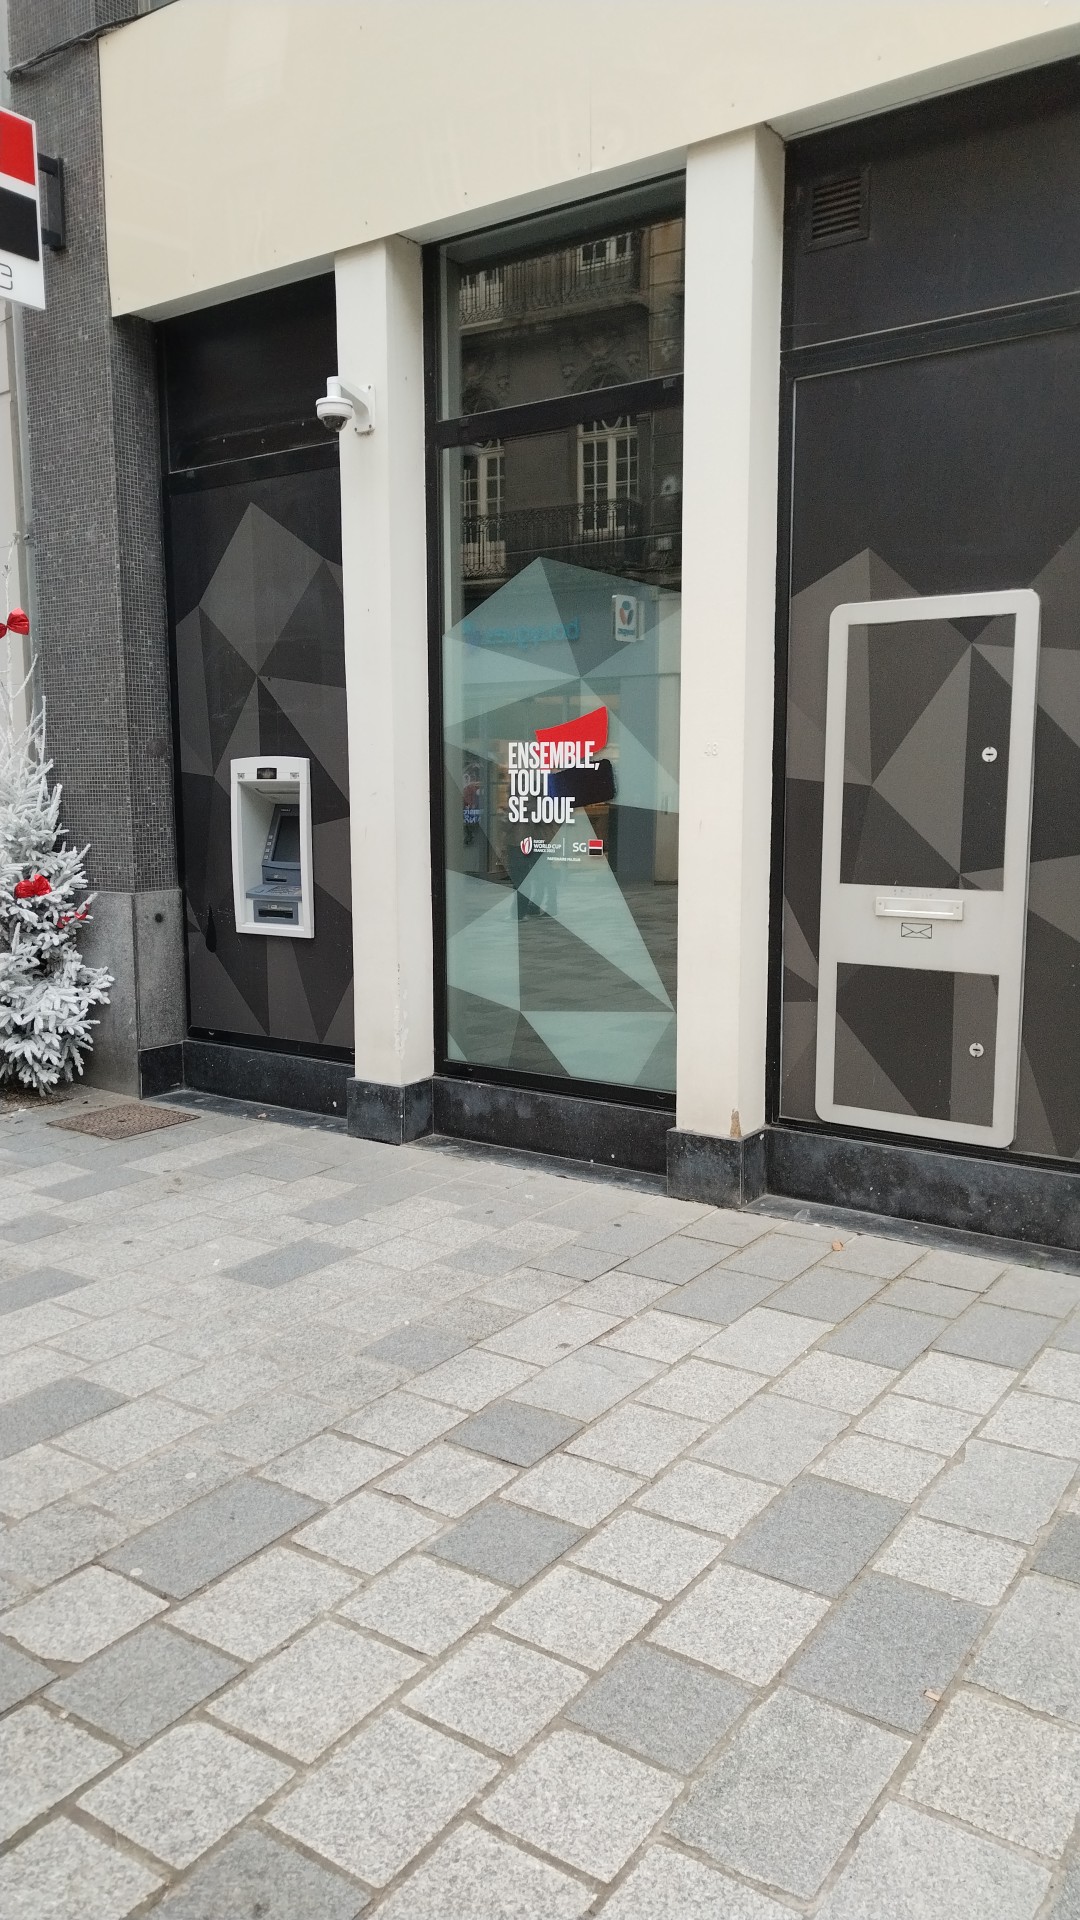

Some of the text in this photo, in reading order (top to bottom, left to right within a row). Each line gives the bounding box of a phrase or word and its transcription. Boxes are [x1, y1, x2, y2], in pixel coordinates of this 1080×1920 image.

[508, 740, 600, 771] ENSEMBLE,
[508, 769, 551, 797] TOUT
[508, 796, 529, 823] SE
[531, 796, 576, 824] JOUE
[572, 842, 587, 853] SG
